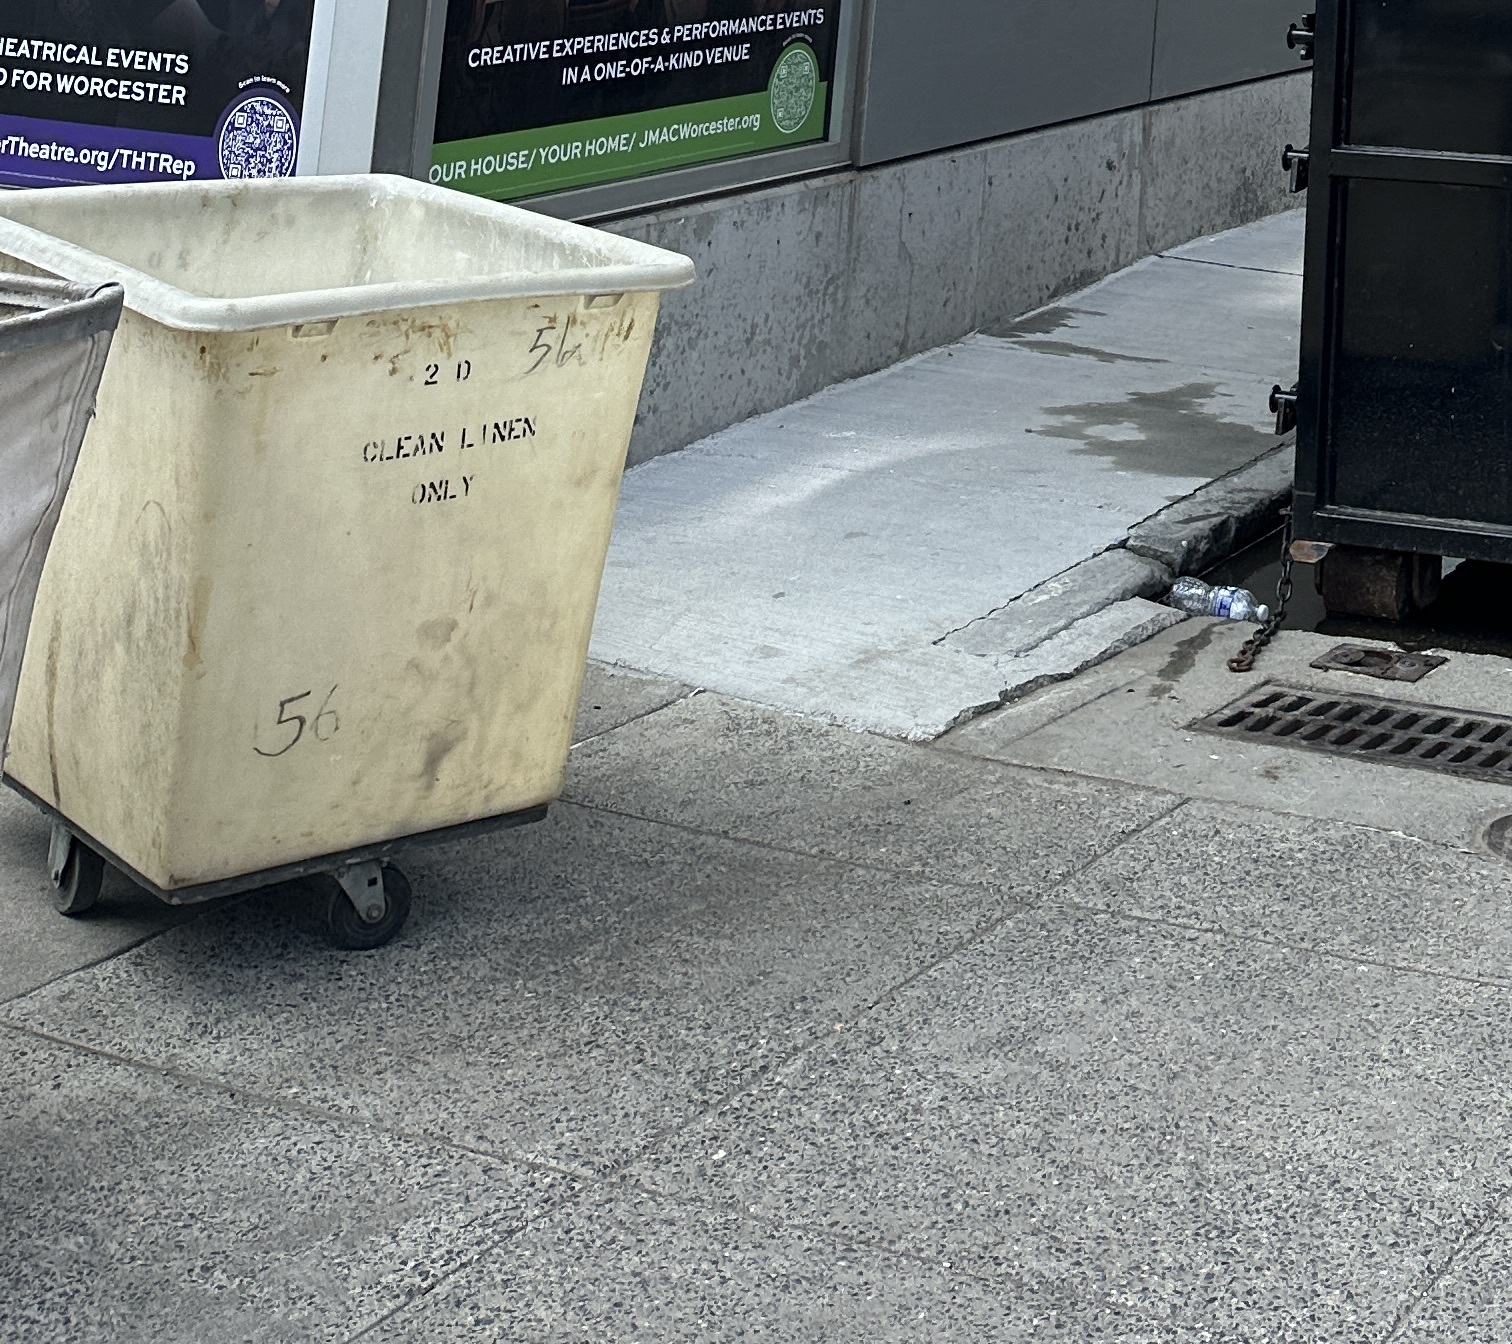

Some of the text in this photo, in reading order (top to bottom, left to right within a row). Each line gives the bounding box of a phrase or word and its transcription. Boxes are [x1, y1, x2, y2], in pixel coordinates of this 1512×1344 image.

[468, 41, 550, 68] CREATIVE
[552, 28, 660, 58] EXPERIENCES
[660, 28, 671, 43] &
[673, 16, 774, 43] PERFORMANCE
[776, 8, 824, 27] EVENTS
[106, 47, 189, 74] EVENTS
[561, 43, 750, 85] IN A ONE-OF-A-KIND VENUE
[11, 69, 53, 92] FOR
[56, 73, 187, 105] WORCESTER
[428, 160, 466, 184] OUR
[538, 141, 581, 165] YOUR
[639, 113, 761, 148] JMACWorcester.org
[363, 416, 537, 462] CLEAN LINEN
[411, 475, 474, 504] ONLY
[254, 684, 340, 757] 56
